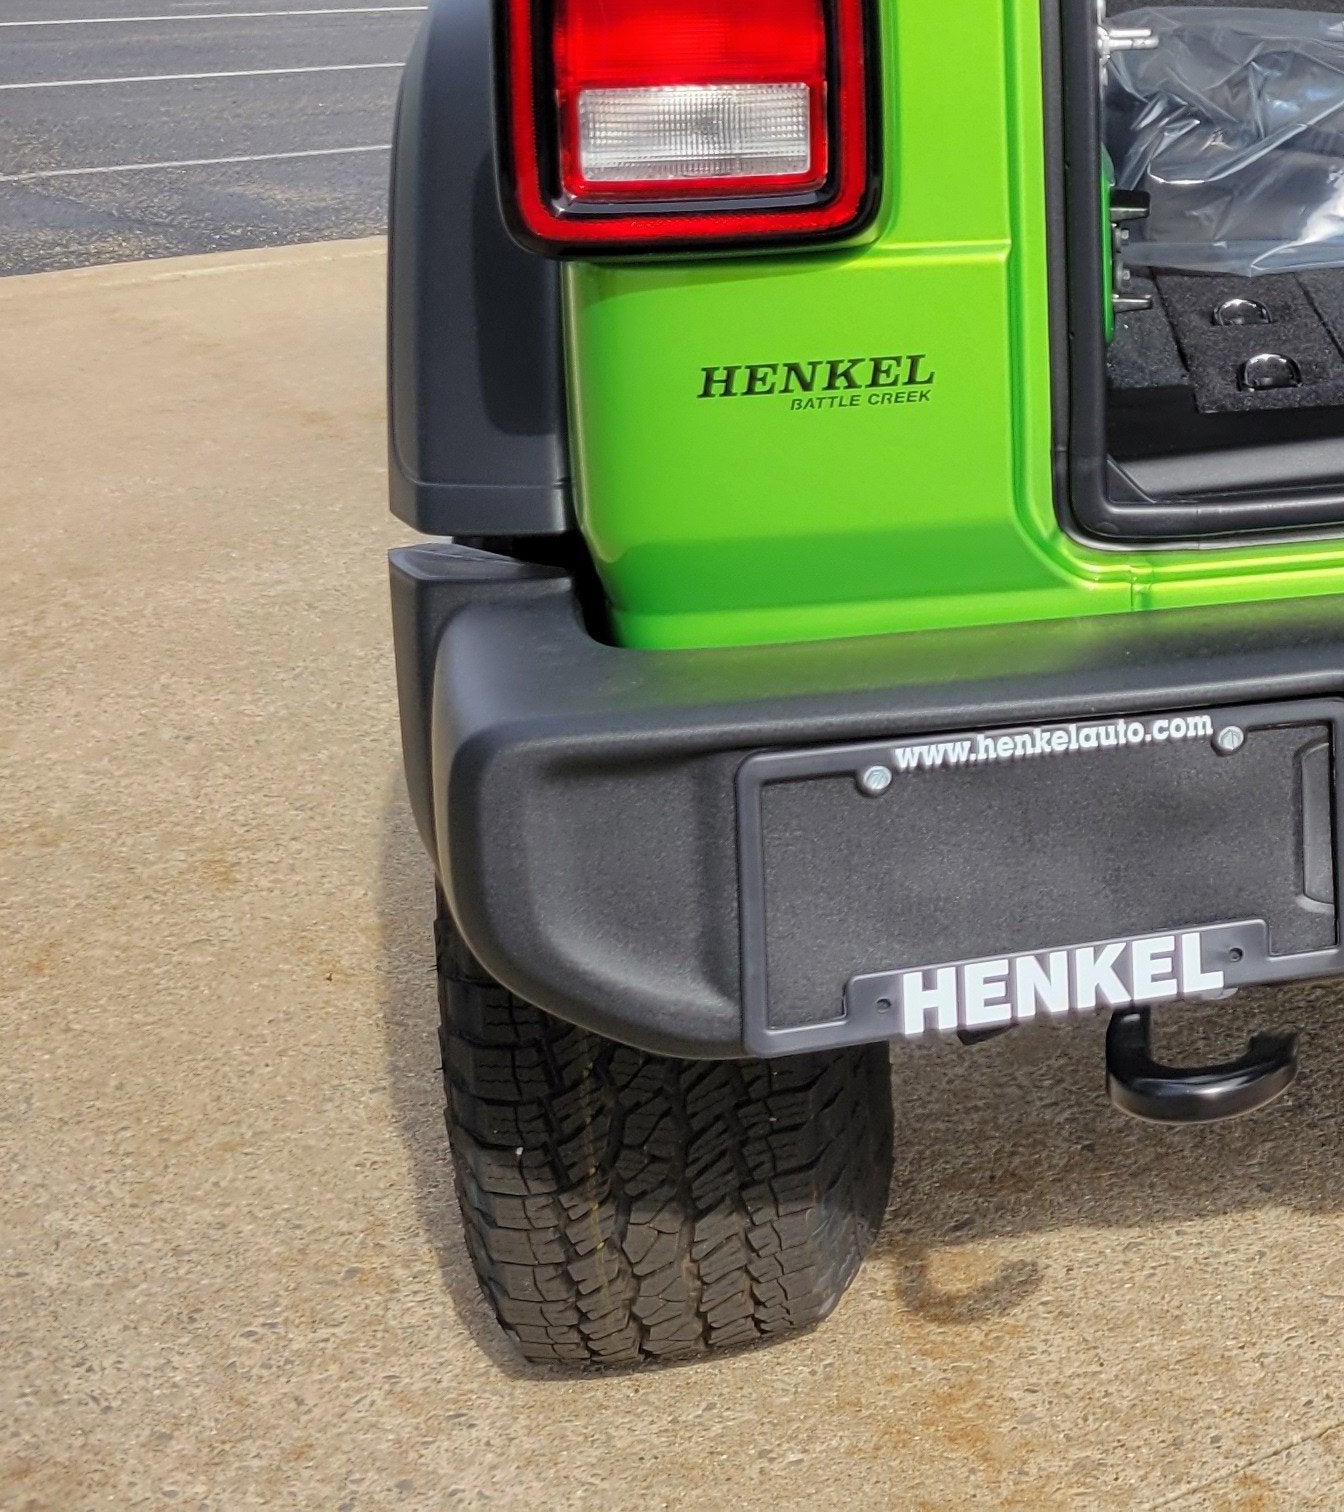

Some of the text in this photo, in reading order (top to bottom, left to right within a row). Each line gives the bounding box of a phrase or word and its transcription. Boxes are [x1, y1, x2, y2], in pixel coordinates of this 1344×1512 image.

[696, 354, 936, 399] HENKEL
[790, 389, 932, 411] BATTLE CREEK
[895, 713, 1213, 769] www.henkelauto.com
[901, 931, 1225, 1036] HENKEL
